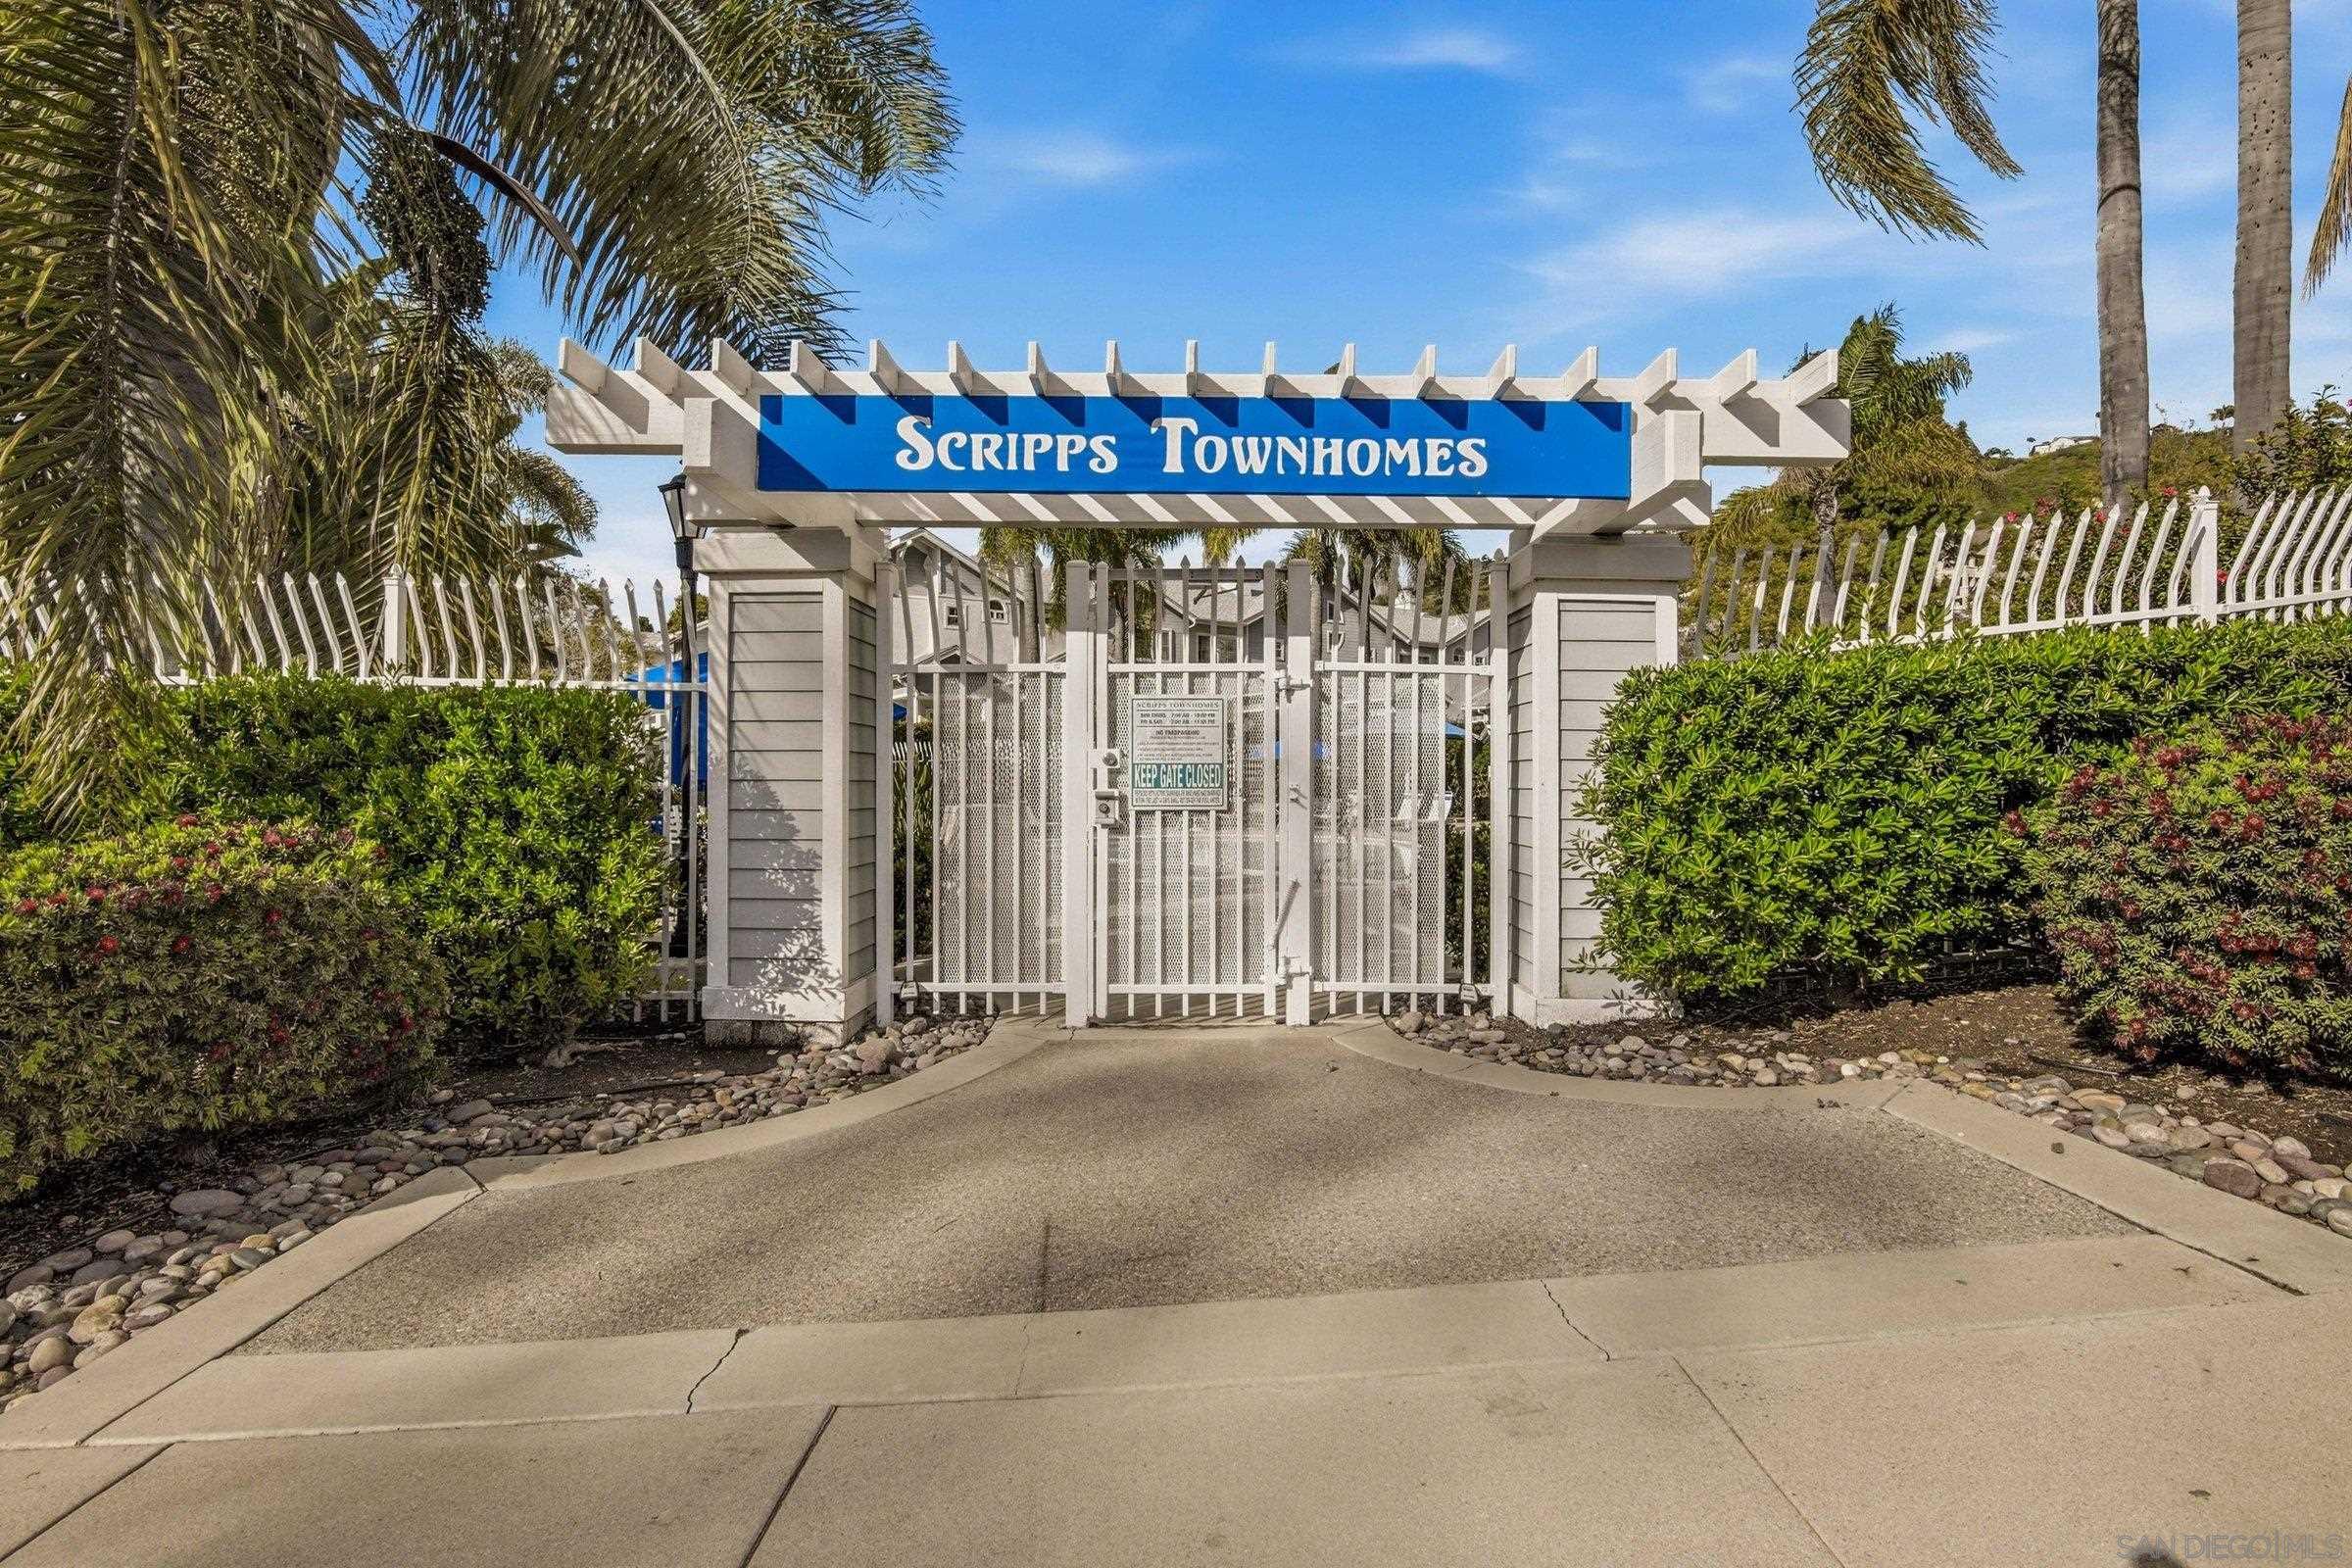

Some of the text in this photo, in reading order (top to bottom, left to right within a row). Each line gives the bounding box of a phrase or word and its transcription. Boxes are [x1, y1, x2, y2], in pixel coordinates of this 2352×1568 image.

[896, 415, 1488, 477] SCRIPPS TOWNHOMES
[1135, 764, 1221, 788] KEEP GATE CLOSED
